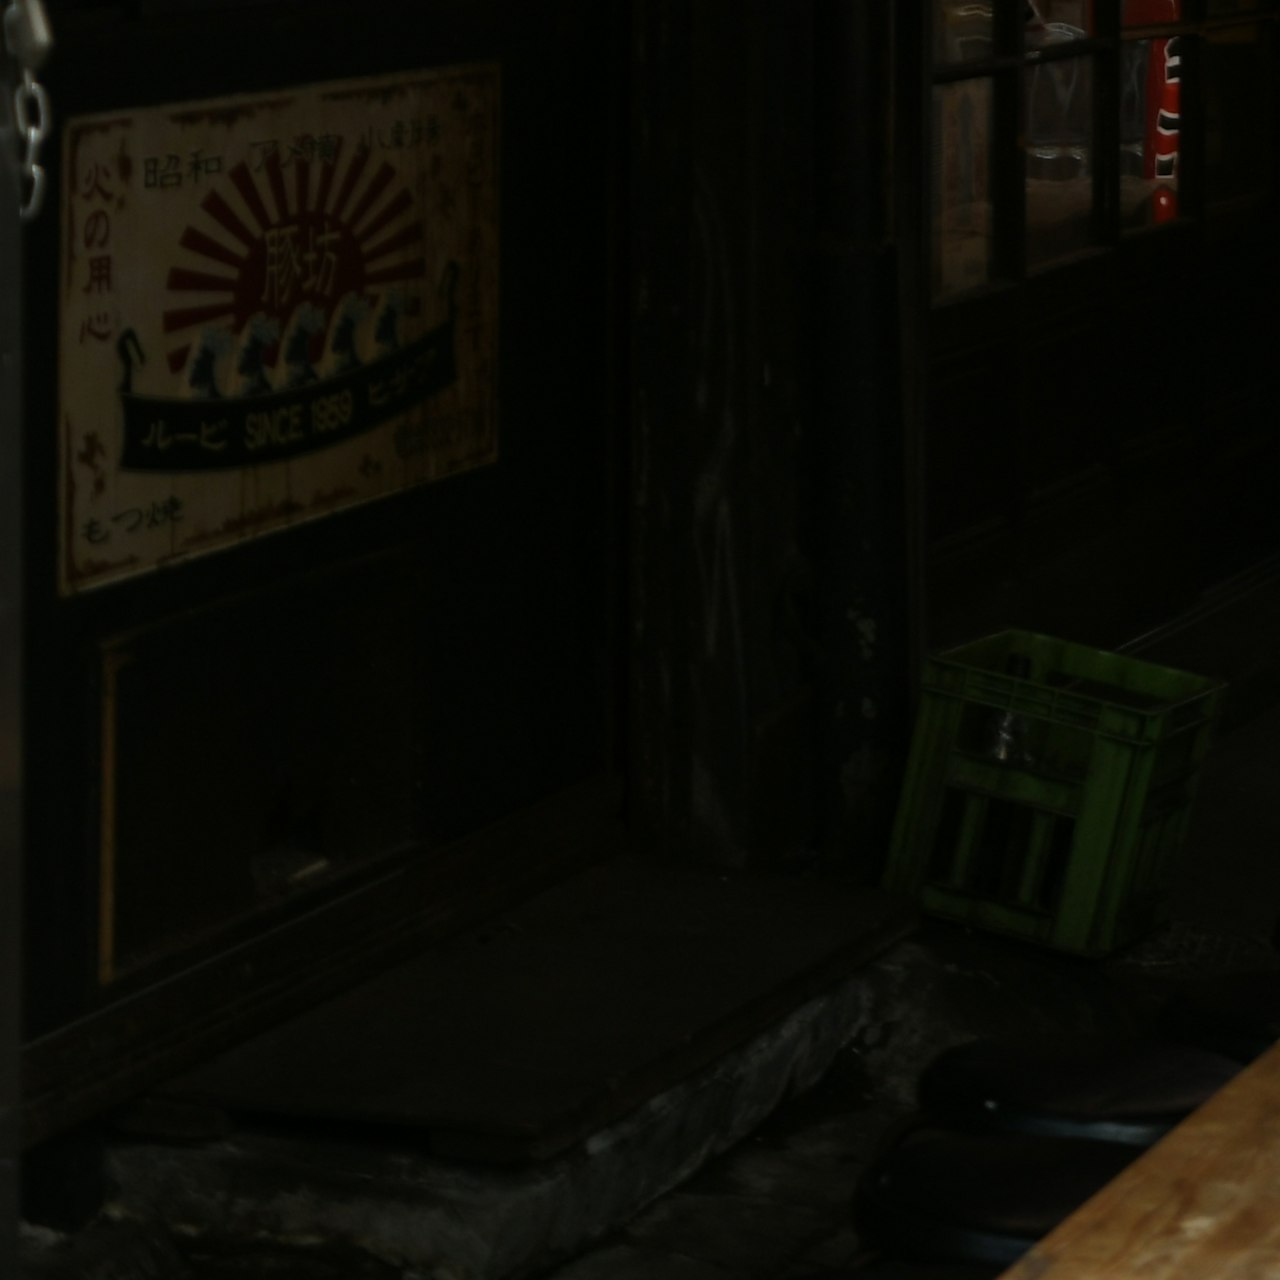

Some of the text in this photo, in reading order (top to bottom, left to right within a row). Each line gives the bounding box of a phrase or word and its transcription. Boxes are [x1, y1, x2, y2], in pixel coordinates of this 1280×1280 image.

[143, 149, 223, 190] 昭和
[79, 164, 115, 344] 火の用心
[259, 223, 343, 310] 豚坊
[142, 419, 229, 451] ルービ
[243, 402, 305, 450] SINCE
[310, 387, 354, 434] 1959
[83, 496, 184, 546] もつ焼
